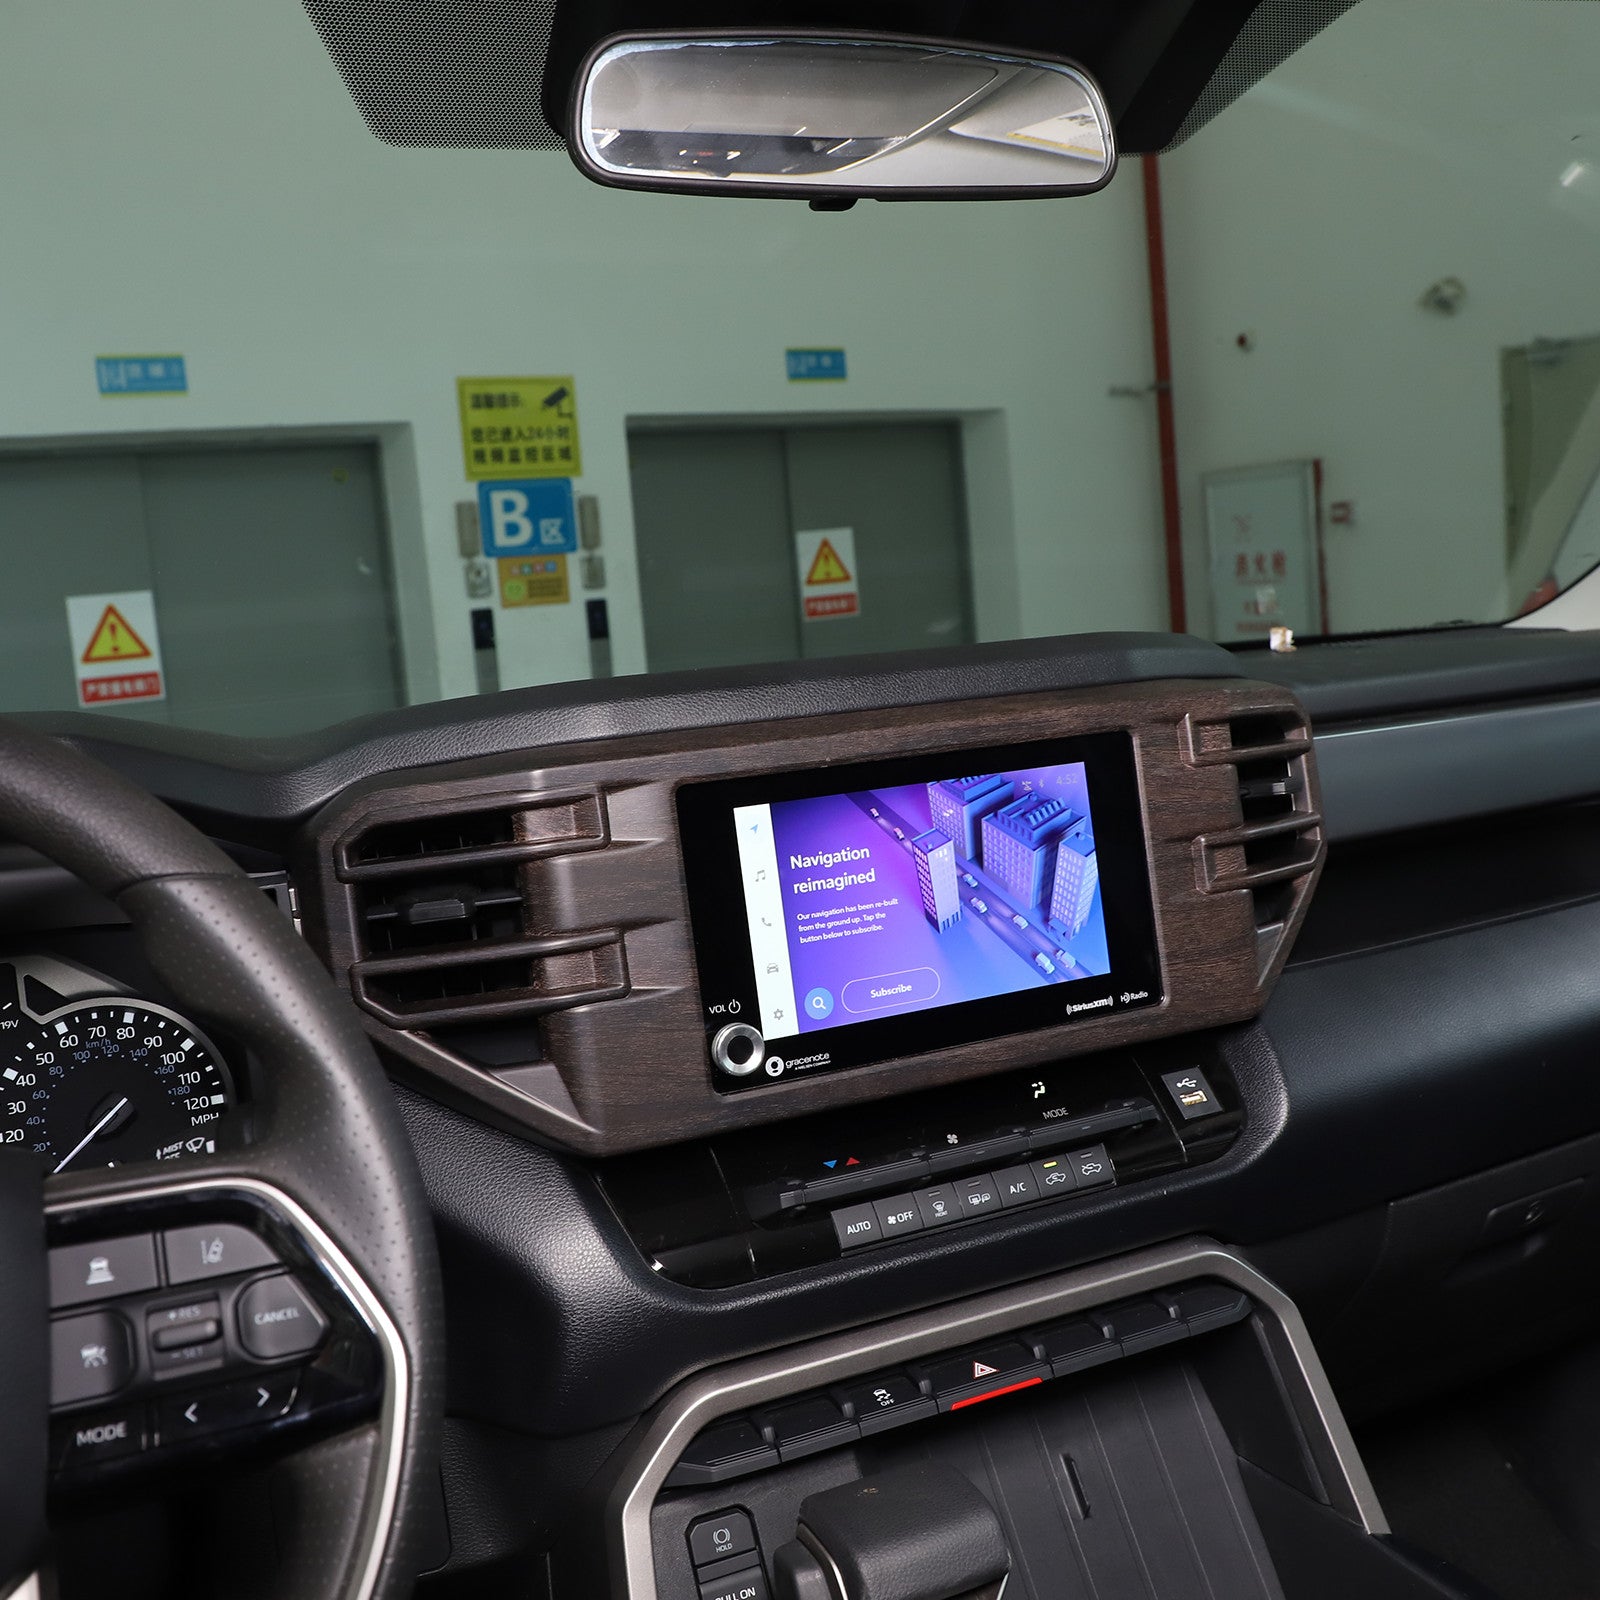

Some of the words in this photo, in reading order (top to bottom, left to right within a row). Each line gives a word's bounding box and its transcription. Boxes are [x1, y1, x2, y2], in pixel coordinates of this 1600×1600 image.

[1056, 773, 1079, 785] 4:52
[790, 847, 870, 870] Navigation
[793, 868, 876, 894] reimagined
[796, 912, 811, 921] Our
[811, 907, 845, 918] navigation
[845, 903, 857, 913] has
[858, 901, 874, 910] been
[875, 898, 898, 908] re-built
[798, 924, 814, 932] from
[814, 922, 826, 930] the
[826, 916, 850, 928] ground
[851, 916, 862, 924] up.
[862, 914, 874, 922] Tap
[875, 912, 886, 920] the
[800, 935, 822, 944] button
[822, 931, 844, 940] below
[852, 924, 884, 935] subscribe.
[870, 982, 912, 999] Subscribe
[1130, 991, 1148, 1000] Radio
[708, 1004, 726, 1014] VOL
[87, 1025, 107, 1040] 70
[116, 1026, 136, 1040] 80
[59, 1034, 78, 1048] 60
[86, 1038, 111, 1049] km/h
[144, 1035, 162, 1049] 90
[72, 1050, 90, 1061] 100
[102, 1044, 120, 1055] 120
[130, 1047, 148, 1058] 140
[36, 1051, 54, 1066] 50
[160, 1051, 186, 1066] 100
[785, 1052, 830, 1069] gracenote
[48, 1065, 63, 1076] 80
[158, 1065, 175, 1076] 160
[16, 1074, 36, 1087] 40
[178, 1071, 201, 1086] 110
[32, 1090, 46, 1100] 60
[172, 1085, 190, 1096] 180
[7, 1100, 26, 1116] 30
[184, 1096, 209, 1111] 120
[1042, 1106, 1069, 1120] MODE
[26, 1116, 40, 1126] 40
[4, 1129, 24, 1144] 20
[32, 1143, 46, 1153] 20
[162, 1141, 184, 1156] MIST
[1009, 1180, 1027, 1195] A/C
[896, 1209, 914, 1224] OFF
[846, 1218, 872, 1235] AUTO
[254, 1305, 300, 1326] CANCEL
[880, 1398, 896, 1408] OFF
[76, 1421, 127, 1446] MODE
[715, 1542, 733, 1553] HOLD
[740, 1586, 756, 1600] ON
